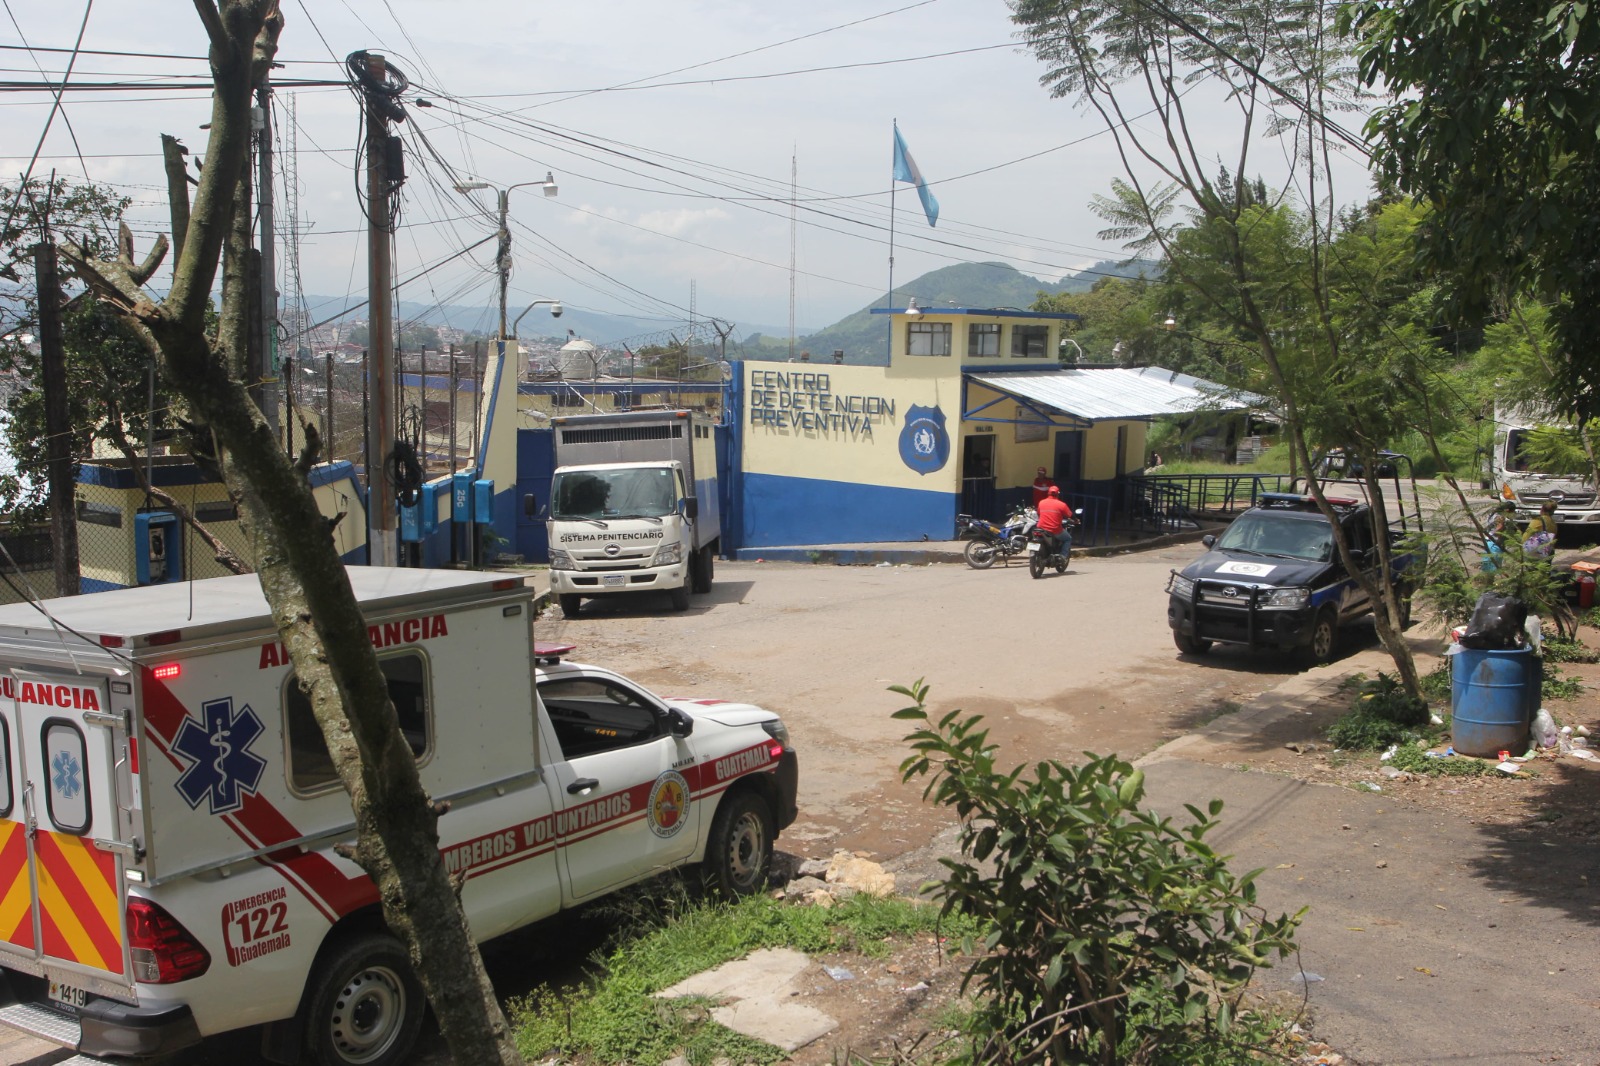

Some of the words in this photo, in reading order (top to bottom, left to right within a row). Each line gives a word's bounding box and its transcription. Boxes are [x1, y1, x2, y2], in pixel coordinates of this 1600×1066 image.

[751, 370, 829, 391] CENTRO
[751, 389, 776, 408] DE
[779, 391, 895, 416] DETENCION
[750, 408, 872, 434] PREVENTIVA
[560, 534, 596, 543] SISTEMA
[597, 532, 664, 540] PENITENCIARIO
[259, 614, 448, 670] AANCIA
[715, 744, 771, 780] GUATEMALA
[523, 792, 632, 846] VOLUNTARIOS
[234, 887, 287, 913] EMERGENCIA
[236, 902, 289, 943] 122
[240, 932, 291, 963] Guatemala
[60, 984, 85, 1006] 1419
